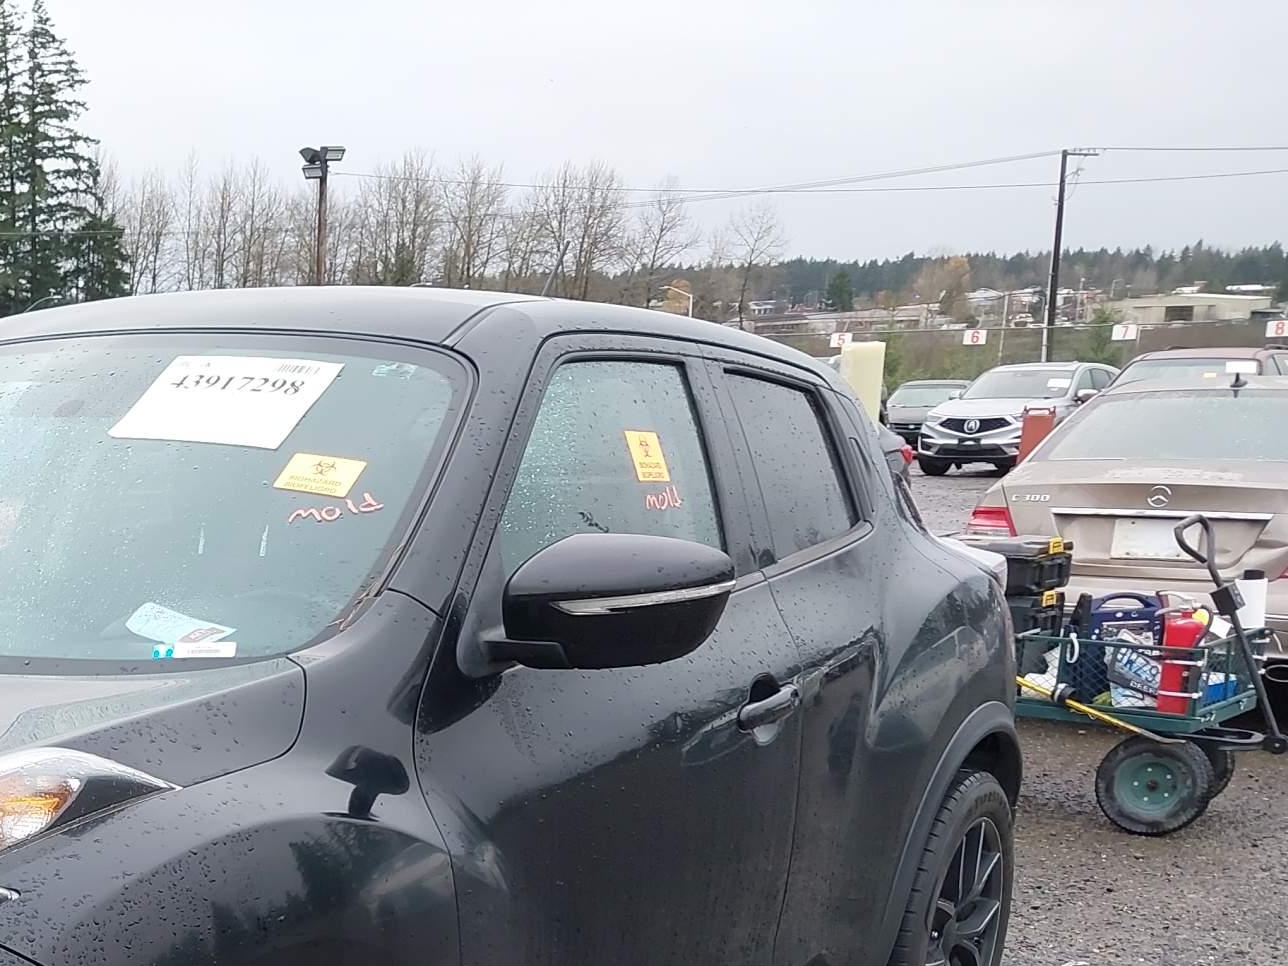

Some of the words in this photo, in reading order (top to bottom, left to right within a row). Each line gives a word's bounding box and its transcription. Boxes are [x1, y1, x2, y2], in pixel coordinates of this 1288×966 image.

[1120, 325, 1129, 339] 7
[1274, 321, 1286, 336] 8
[837, 333, 846, 346] 5
[970, 330, 980, 344] 6
[169, 374, 306, 396] 43917298
[1022, 494, 1050, 502] 300
